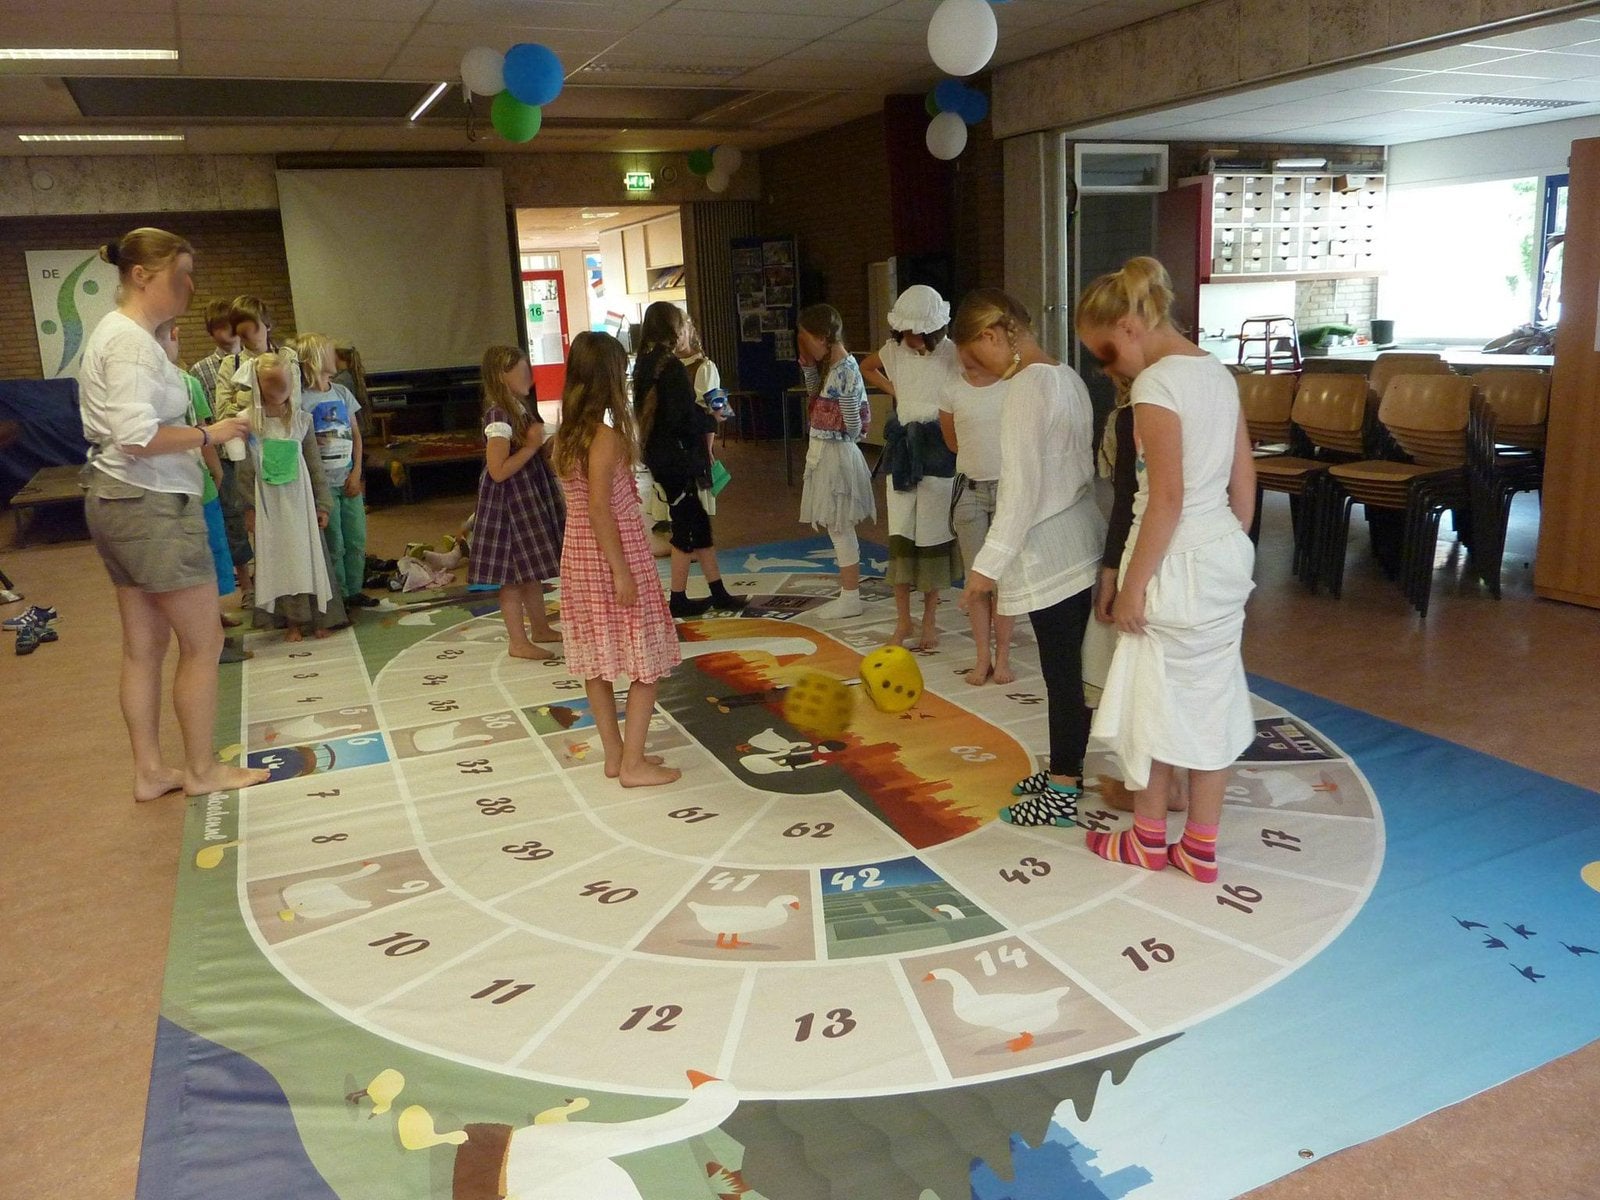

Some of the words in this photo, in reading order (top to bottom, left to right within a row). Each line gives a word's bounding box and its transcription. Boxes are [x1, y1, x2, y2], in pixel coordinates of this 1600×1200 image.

[42, 269, 61, 280] DE
[529, 306, 542, 317] 16
[289, 651, 312, 659] 2
[293, 672, 319, 680] 3
[422, 674, 449, 687] 34
[552, 679, 583, 691] 57
[339, 707, 368, 716] 5
[427, 699, 459, 713] 35
[481, 713, 517, 730] 36
[347, 737, 378, 746] 6
[949, 745, 998, 764] 63
[457, 757, 494, 775] 37
[307, 789, 341, 798] 7
[476, 796, 517, 816] 38
[667, 805, 720, 825] 61
[782, 821, 835, 840] 62
[1076, 810, 1119, 832] 44
[311, 833, 349, 845] 8
[1260, 827, 1303, 853] 17
[501, 840, 555, 862] 39
[830, 867, 884, 891] 42
[998, 855, 1052, 885] 43
[385, 879, 430, 895] 9
[706, 870, 762, 893] 41
[578, 879, 639, 905] 40
[1215, 883, 1263, 915] 16
[367, 930, 431, 958] 10
[973, 943, 1030, 977] 14
[1120, 937, 1176, 972] 15
[470, 977, 537, 1005] 11
[618, 1004, 684, 1033] 12
[793, 1007, 858, 1043] 13
